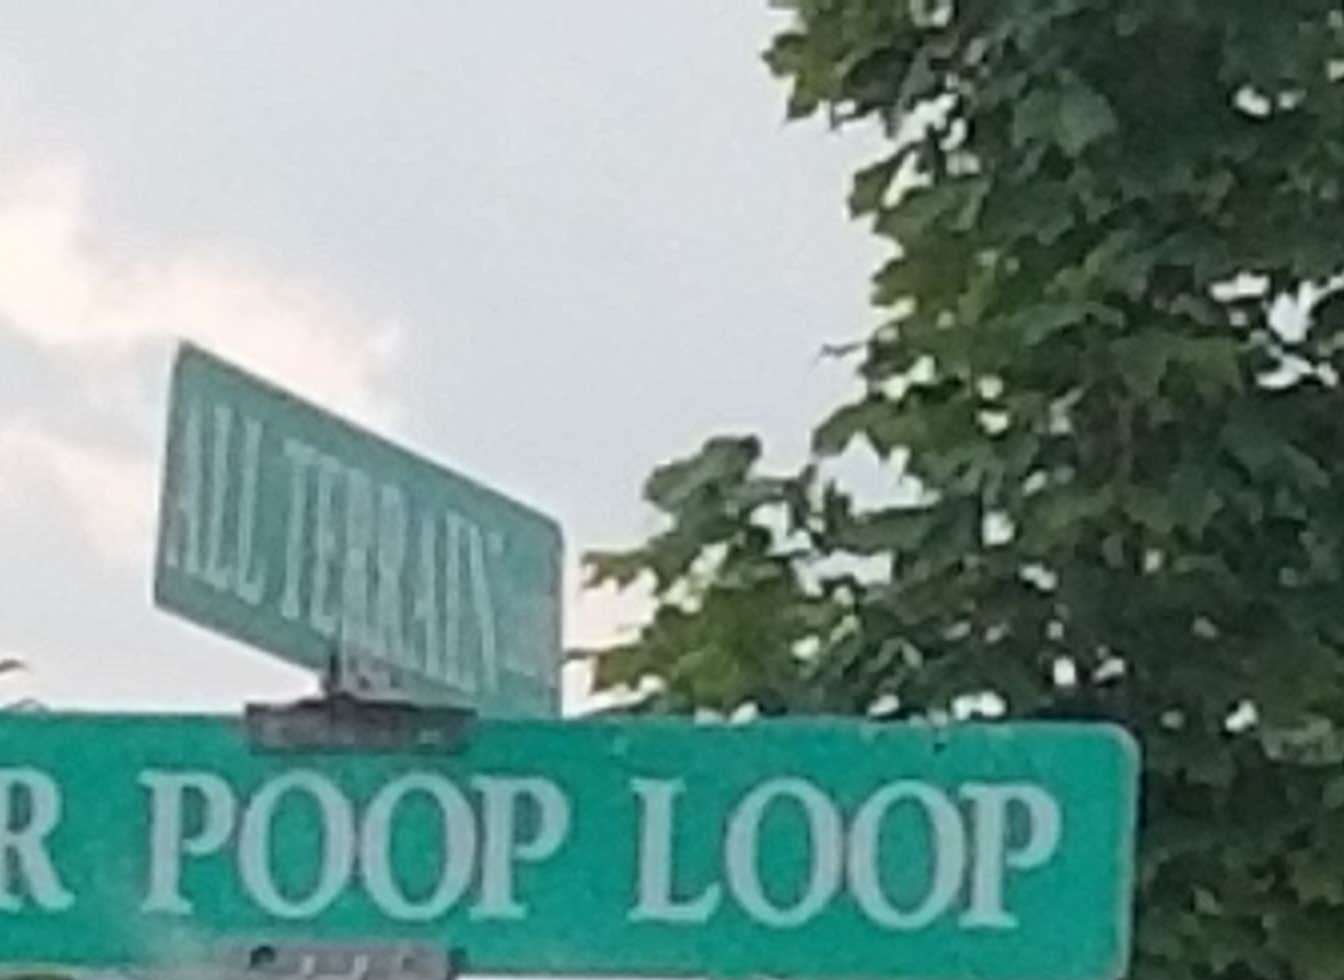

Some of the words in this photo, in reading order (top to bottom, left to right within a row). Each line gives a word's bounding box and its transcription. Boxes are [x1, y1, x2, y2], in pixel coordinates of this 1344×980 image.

[167, 403, 264, 605] ALL
[280, 439, 504, 692] TERRAIN
[141, 769, 570, 921] POOP
[632, 778, 1058, 929] LOOP
